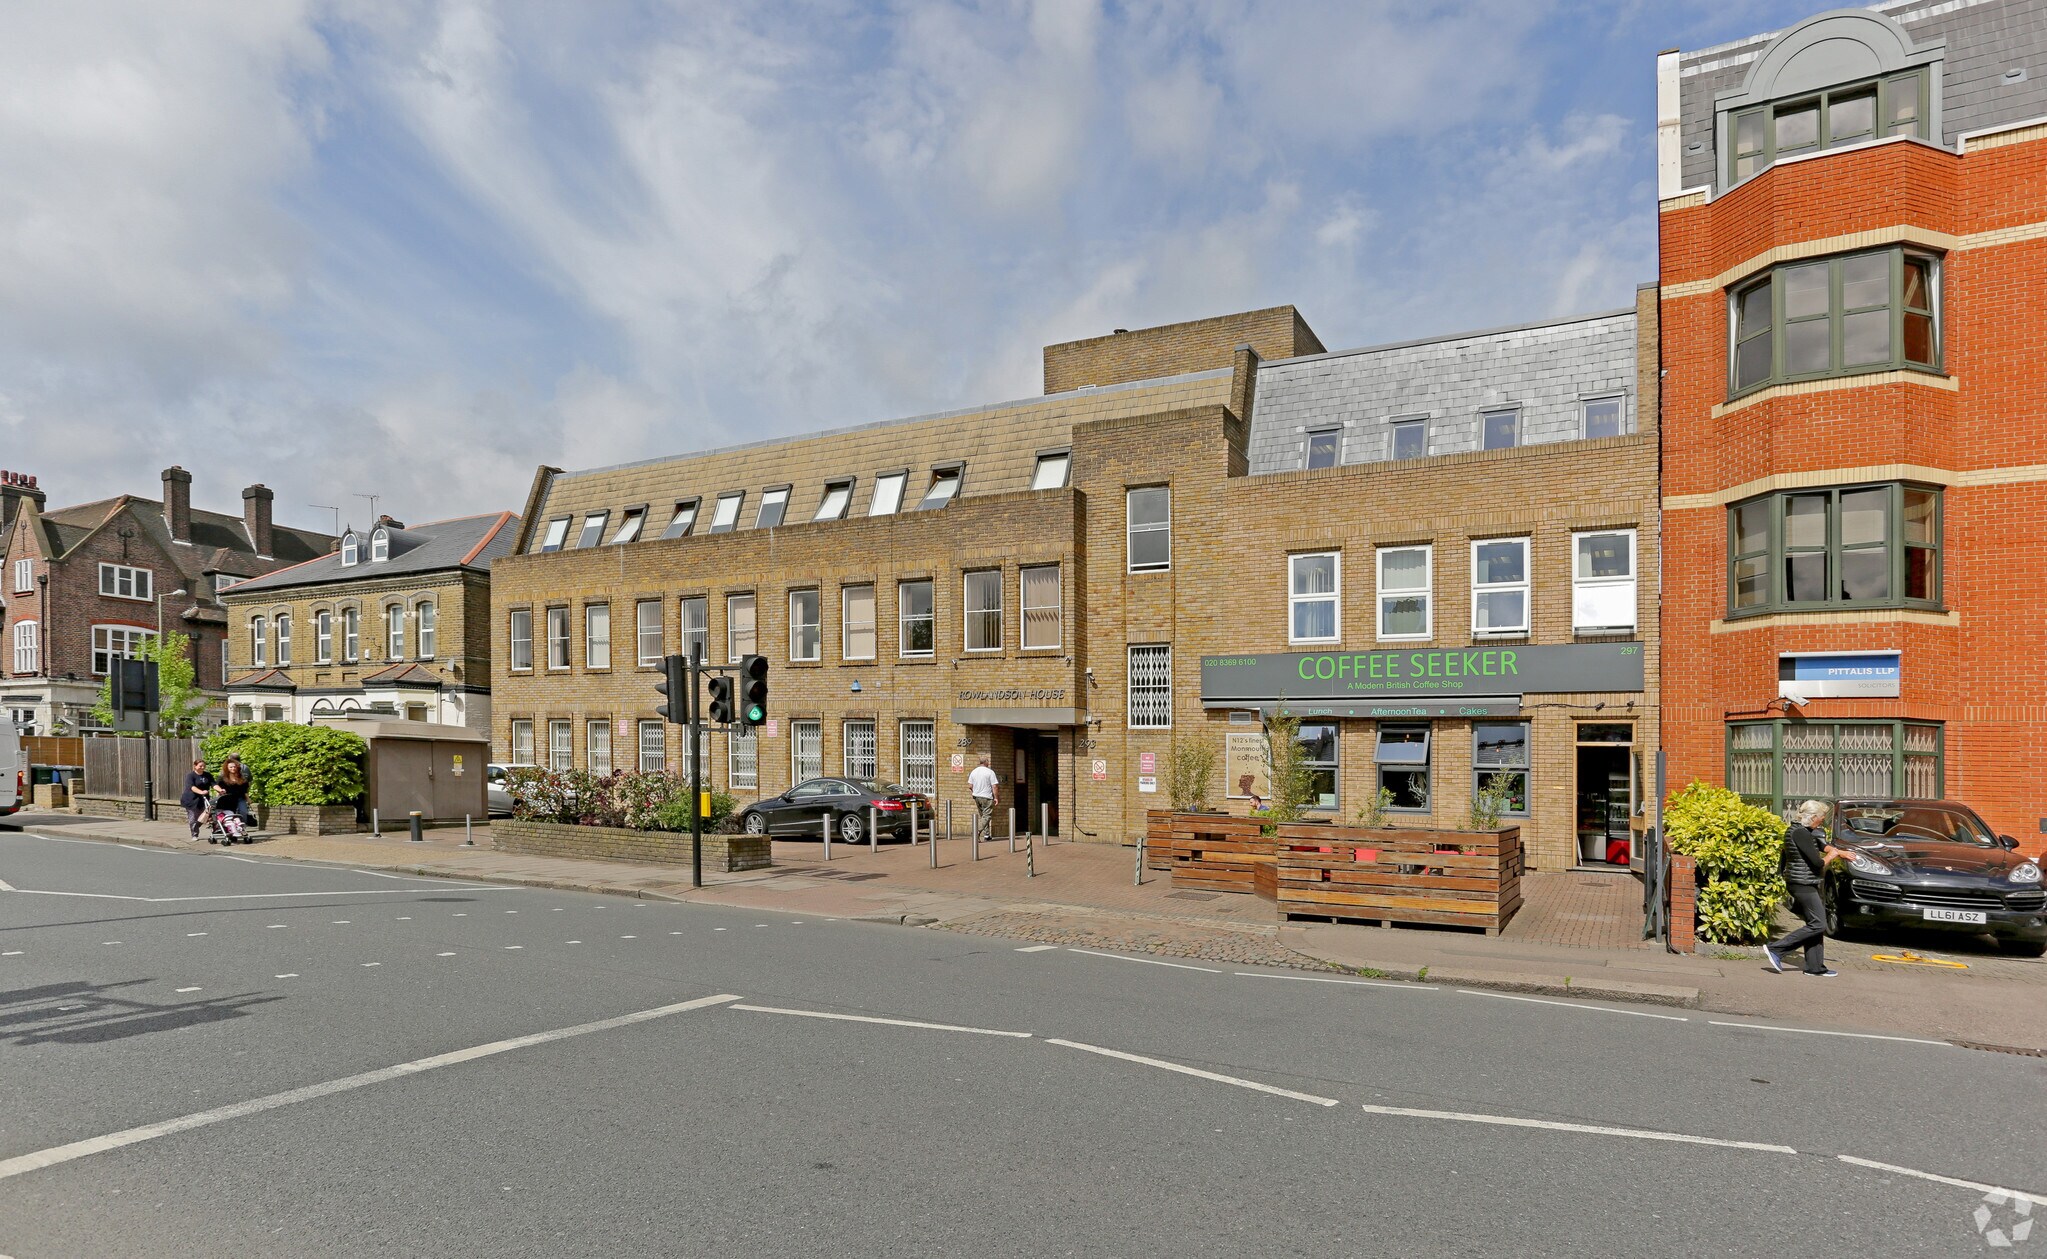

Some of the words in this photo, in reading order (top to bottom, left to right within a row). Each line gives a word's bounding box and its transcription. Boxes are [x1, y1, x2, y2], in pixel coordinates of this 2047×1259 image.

[1620, 646, 1638, 655] 297
[1204, 659, 1218, 667] 020
[1219, 658, 1237, 666] 8369
[1238, 658, 1257, 666] 6100
[1298, 654, 1400, 680] COFFEE
[1410, 650, 1519, 678] SEEKER
[1828, 667, 1873, 675] PITTALIS
[1875, 667, 1895, 675] LLP
[1347, 682, 1354, 690] A
[1354, 682, 1384, 690] Modern
[1386, 681, 1411, 689] British
[1413, 680, 1440, 689] Coffee
[1441, 680, 1464, 689] Shop
[959, 690, 1025, 701] ROWLANDSON
[1030, 689, 1066, 700] HOUSE
[1459, 706, 1488, 715] Cakes
[1079, 738, 1097, 749] 293
[1930, 910, 1955, 920] LL61
[1958, 912, 1979, 921] ASZ
